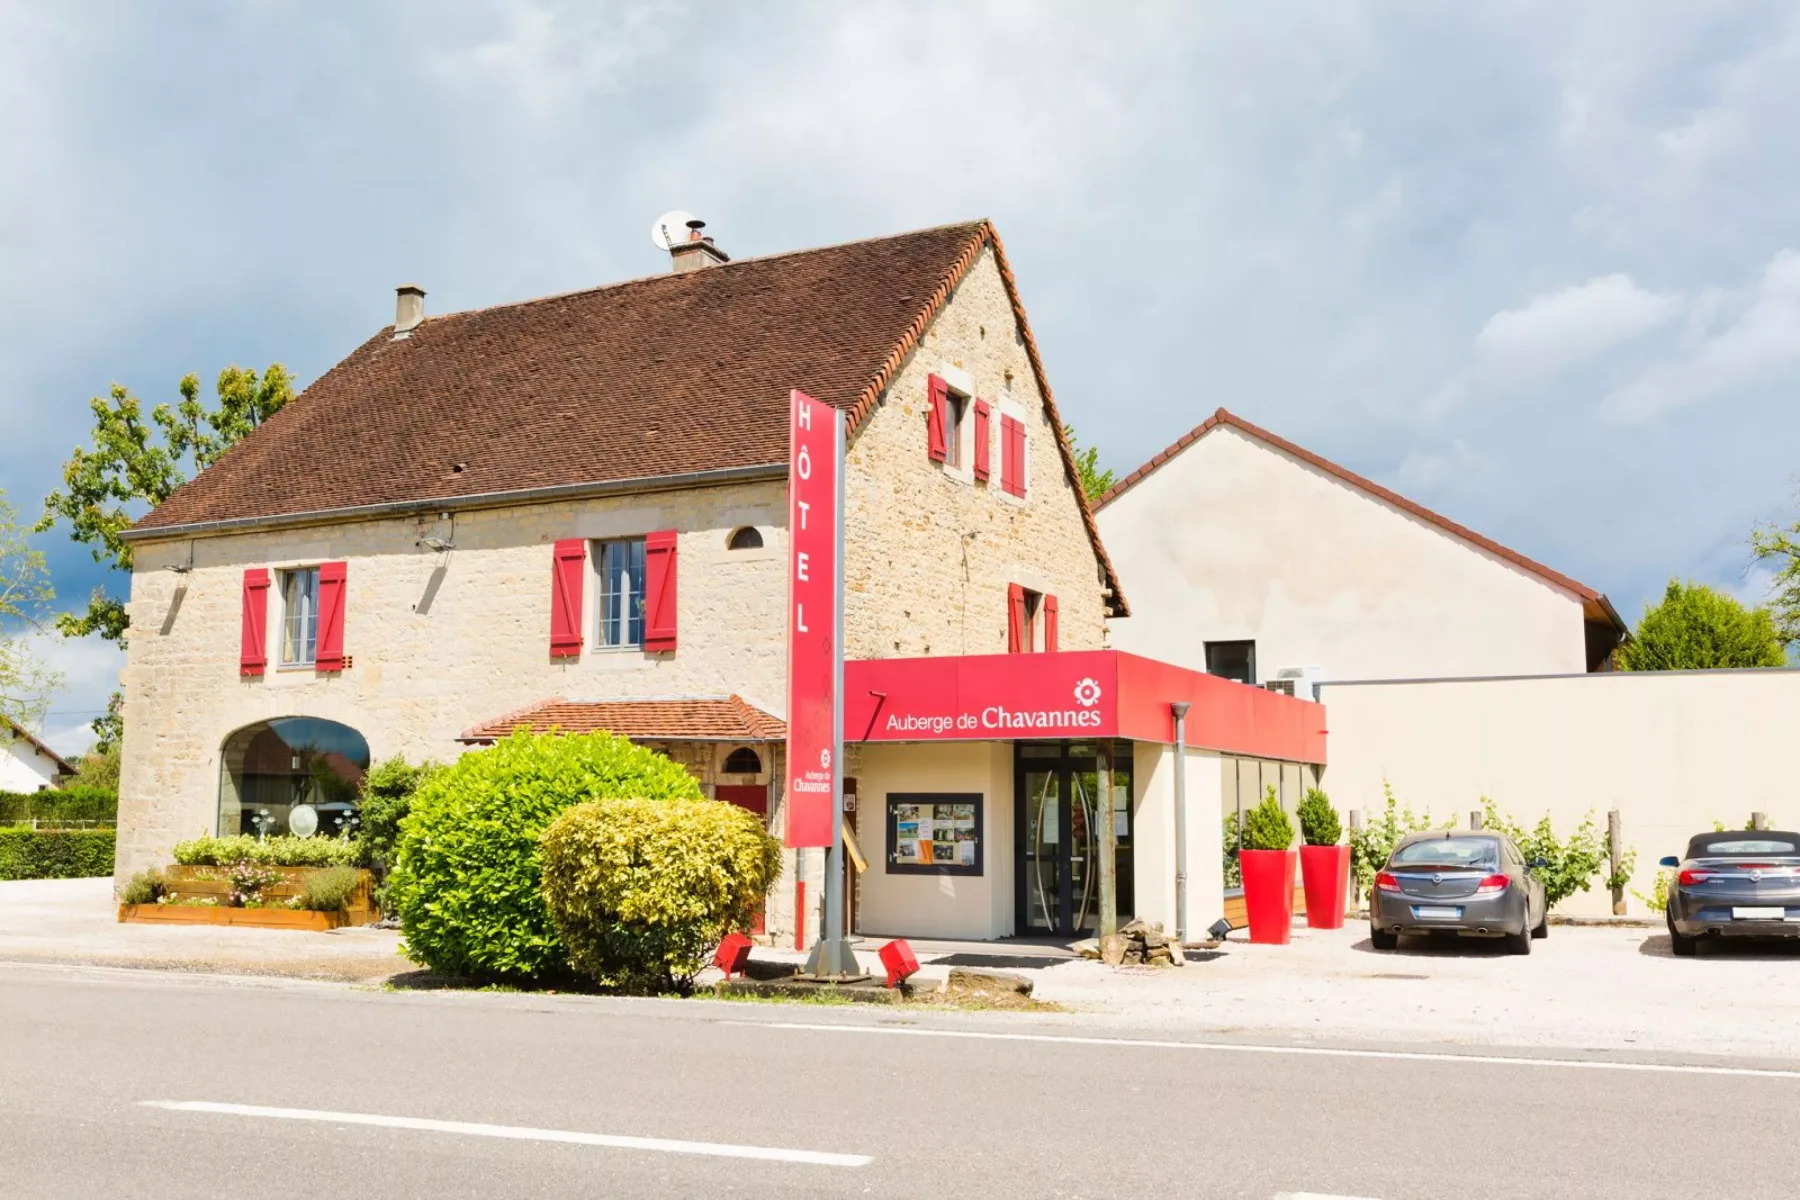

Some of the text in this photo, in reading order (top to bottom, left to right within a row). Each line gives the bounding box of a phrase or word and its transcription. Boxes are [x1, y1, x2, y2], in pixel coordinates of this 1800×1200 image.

[797, 401, 811, 633] HÔTEL
[886, 706, 1101, 733] Auberge de Chavannes
[794, 778, 831, 793] Chavannes
